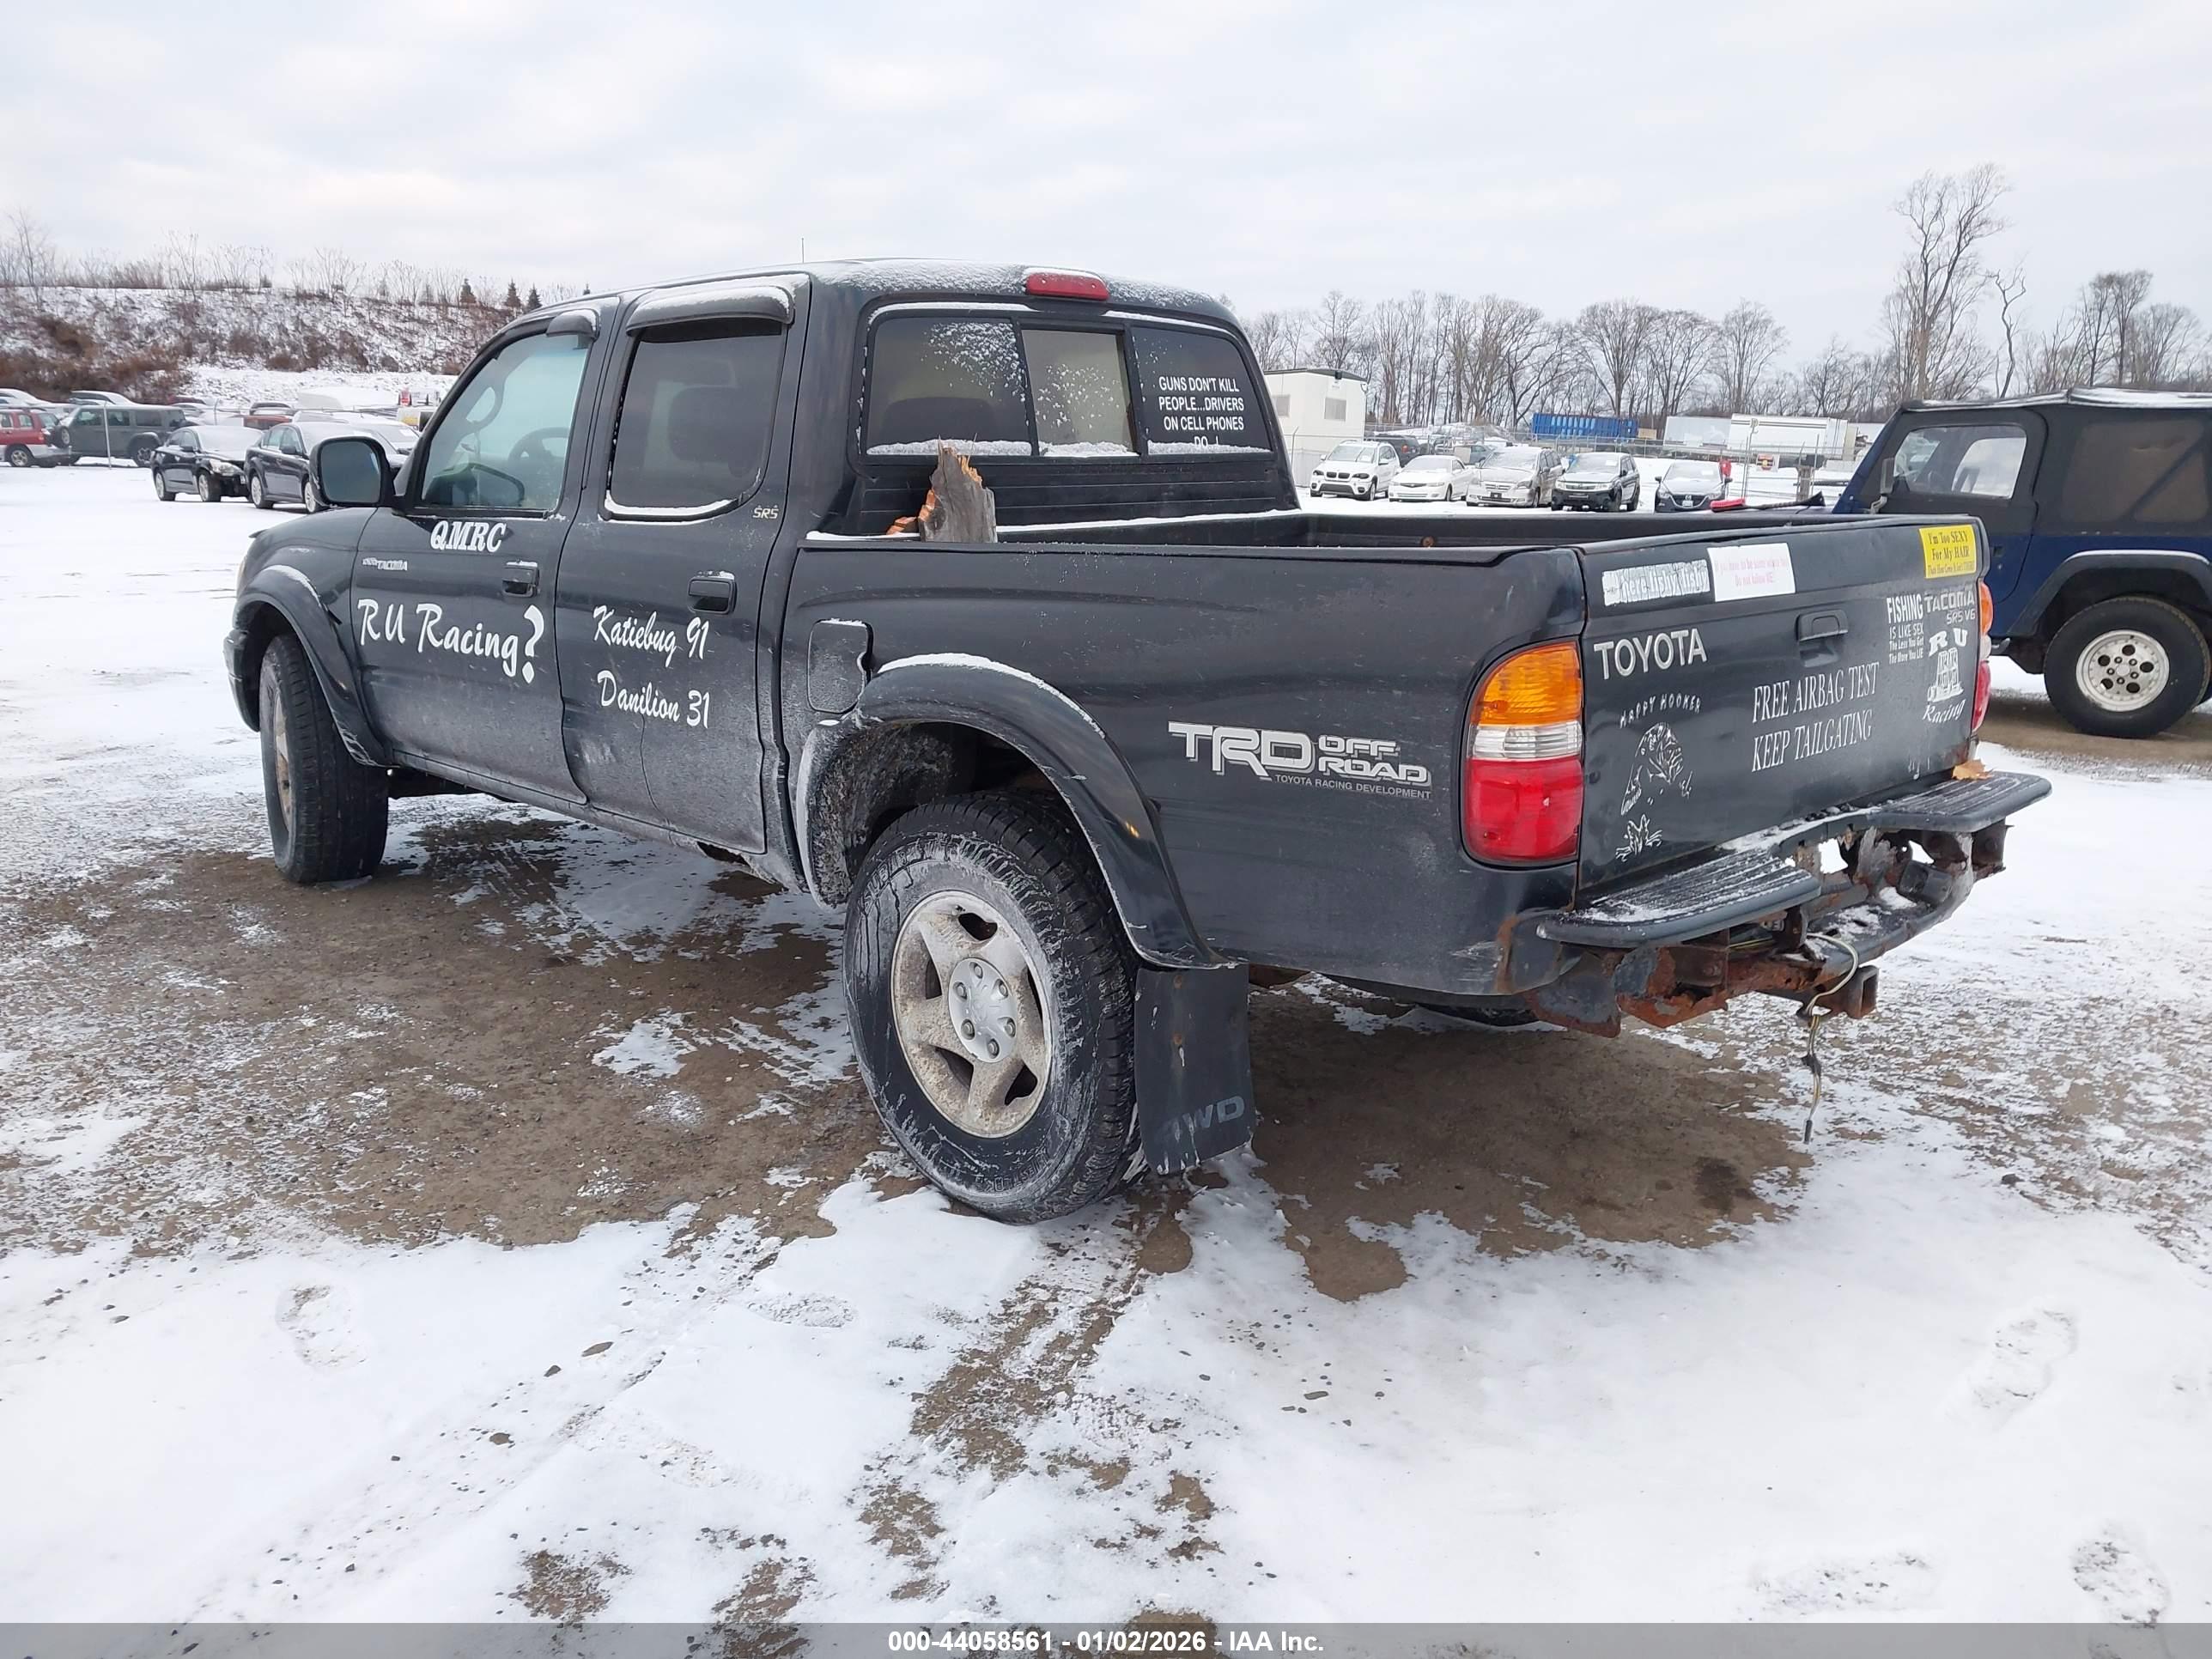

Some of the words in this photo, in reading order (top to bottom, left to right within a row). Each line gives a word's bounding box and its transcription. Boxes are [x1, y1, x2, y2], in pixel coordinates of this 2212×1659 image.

[1159, 376, 1187, 391] GUNS
[1188, 377, 1217, 392] DON'T
[1219, 378, 1240, 392] KILL
[1158, 396, 1244, 411] PEOPLE...DRIVERS
[1164, 416, 1179, 430] ON
[1180, 416, 1205, 430] CELL
[1206, 416, 1244, 430] PHONES
[752, 507, 779, 520] SRS
[430, 520, 507, 553] QMRC
[1939, 532, 1950, 544] Too
[1950, 530, 1968, 544] SEXY
[1932, 548, 1942, 561] For
[1943, 547, 1953, 562] My
[1954, 545, 1970, 558] HAIR
[1887, 593, 1923, 623] FISHING
[1923, 591, 1975, 613] TACOMA
[1947, 610, 1963, 624] SRS
[1965, 608, 1976, 621] V6
[592, 605, 677, 667] Katiebug
[686, 616, 711, 659] 91
[1889, 626, 1896, 640] IS
[1898, 623, 1911, 638] LIKE
[1913, 622, 1923, 636] SEX
[1929, 630, 1948, 657] R
[1953, 628, 1968, 647] U
[1594, 628, 1708, 679] TOYOTA
[597, 670, 682, 723] Danilion
[687, 690, 710, 729] 31
[1753, 680, 1791, 724] FREE
[1793, 670, 1844, 714] AIRBAG
[1848, 662, 1880, 700] TEST
[1620, 696, 1656, 729] HAPPY
[1659, 693, 1701, 714] HOOKER
[1922, 699, 1966, 723] Racing
[1168, 721, 1316, 781] TRD
[1318, 734, 1400, 759] OFF
[1752, 730, 1791, 773] KEEP
[1795, 709, 1873, 760] TAILGATING
[1318, 757, 1431, 787] ROAD
[1275, 774, 1312, 786] TOYOTA
[1315, 778, 1353, 791] RACING
[1356, 782, 1431, 799] DEVELOPMENT
